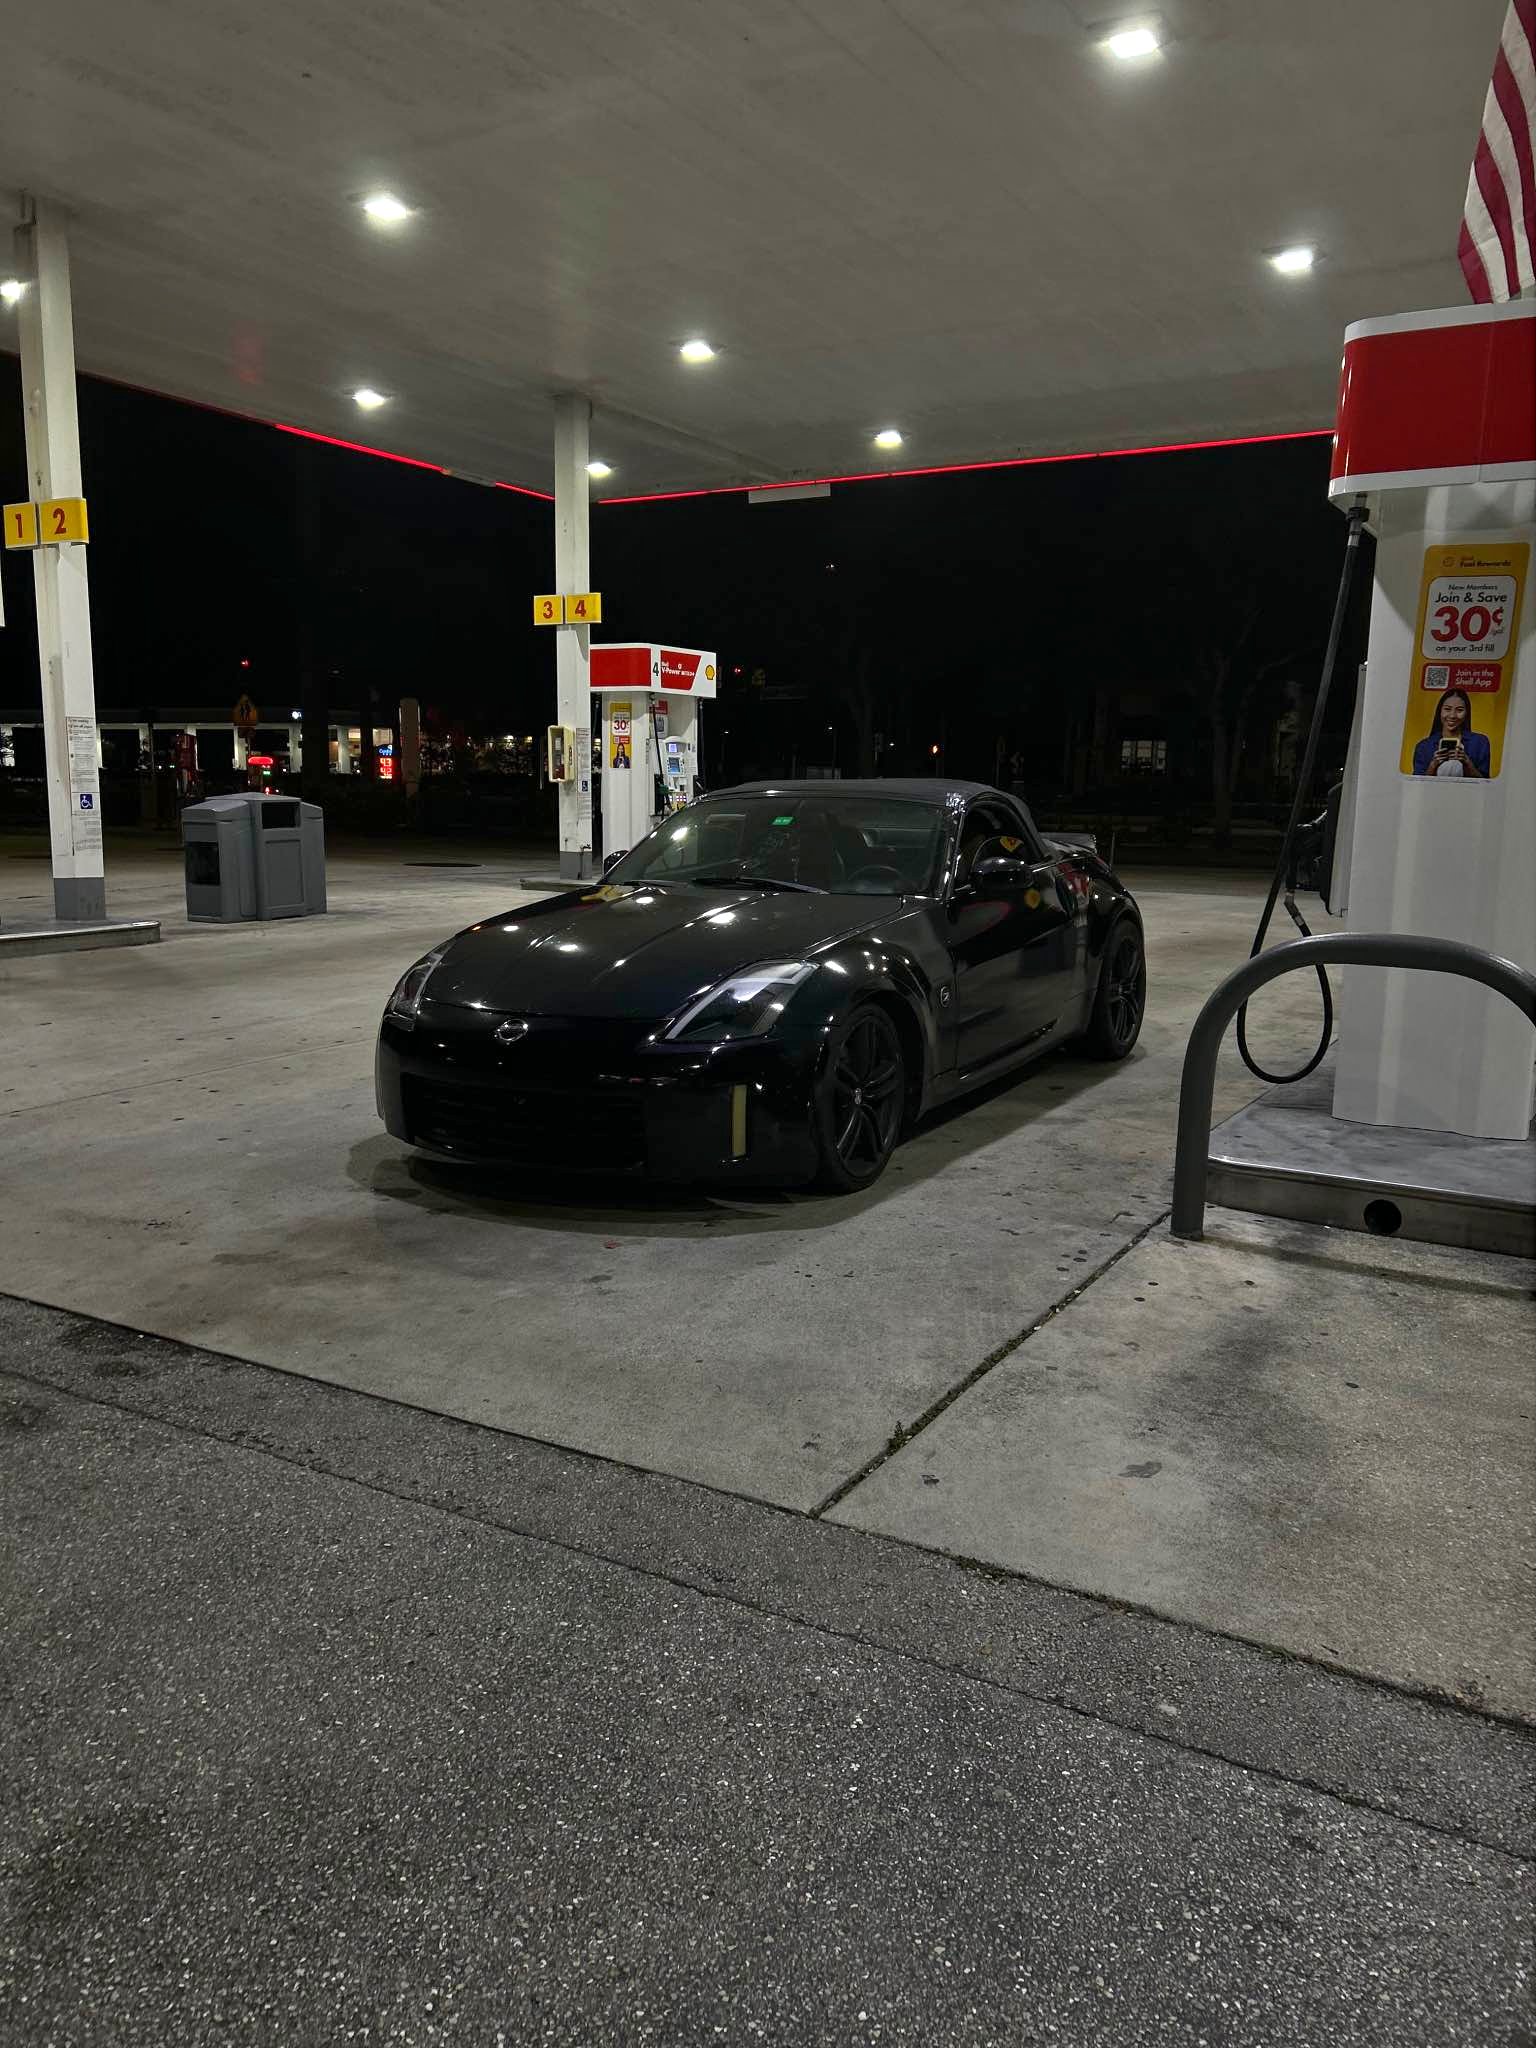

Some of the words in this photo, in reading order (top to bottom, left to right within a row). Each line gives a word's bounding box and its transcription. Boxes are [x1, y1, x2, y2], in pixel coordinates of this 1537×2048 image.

[15, 513, 23, 538] 1
[53, 507, 67, 535] 2
[1435, 592, 1460, 602] Join
[1463, 592, 1473, 603] &
[1477, 592, 1508, 602] Save
[543, 600, 553, 619] 3
[575, 599, 586, 617] 4
[1469, 644, 1484, 652] 3rd
[1485, 644, 1495, 652] fill
[653, 661, 660, 677] 4
[1456, 668, 1472, 677] Join
[1481, 668, 1494, 677] the
[1456, 677, 1474, 685] Shell
[1475, 679, 1491, 687] App
